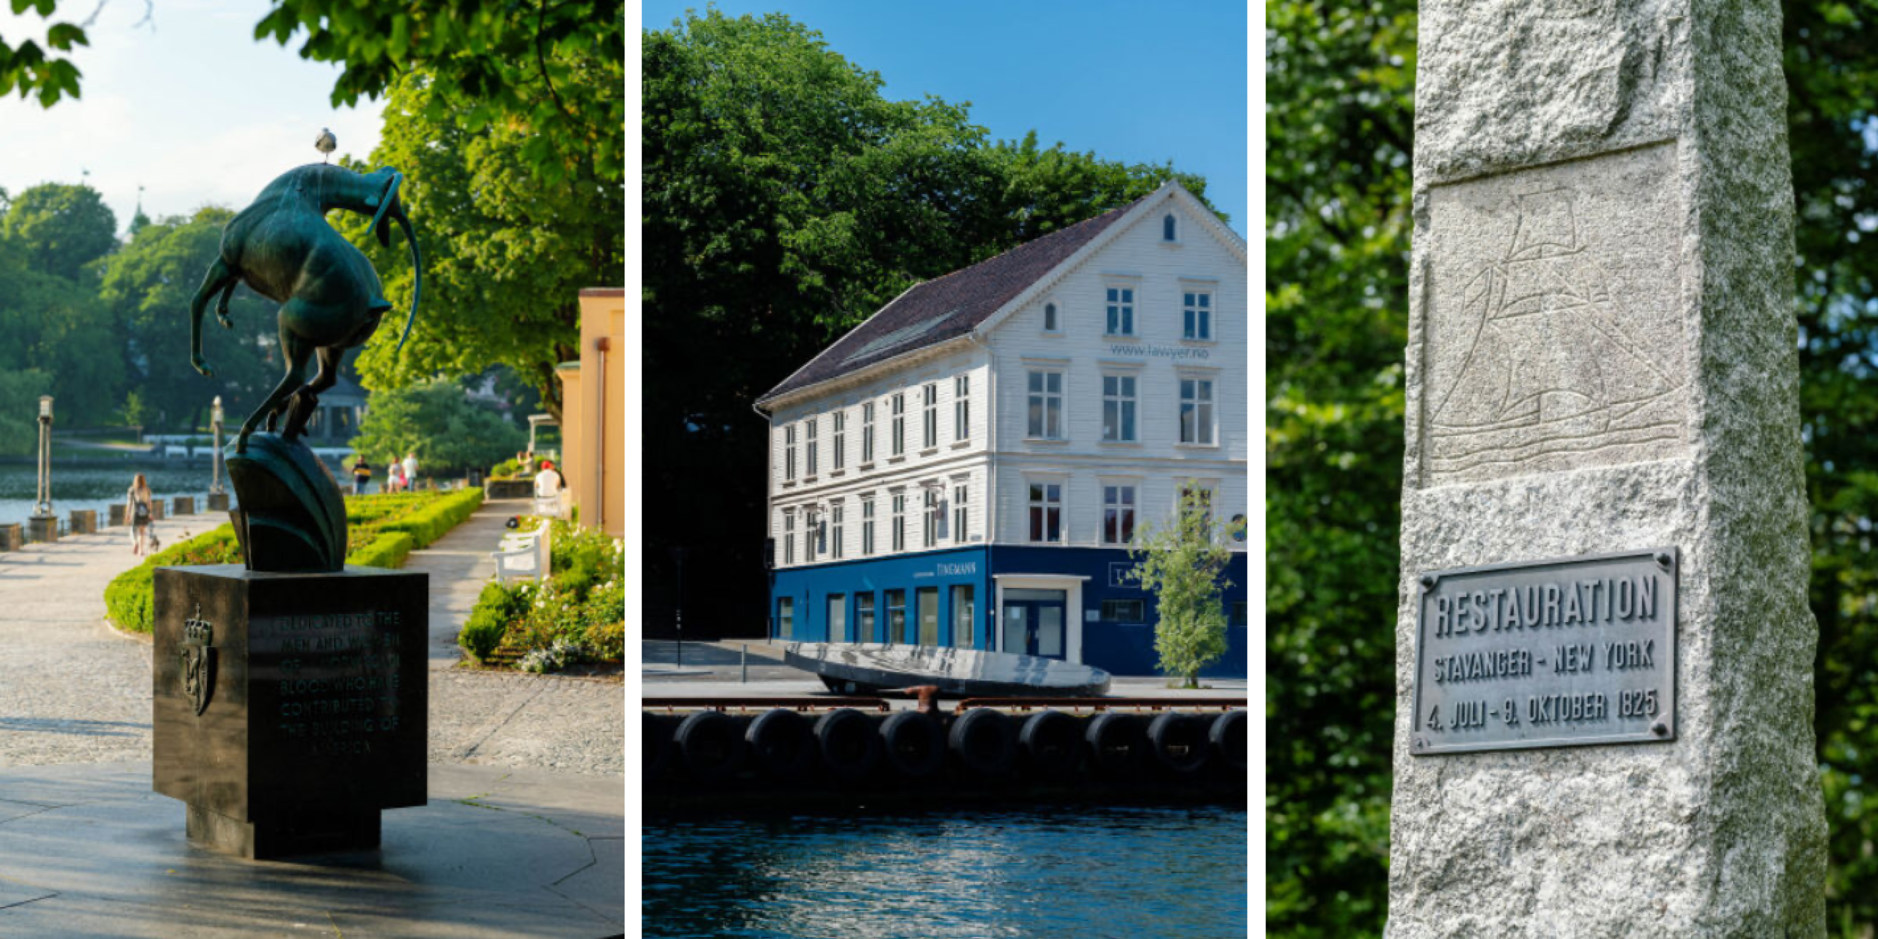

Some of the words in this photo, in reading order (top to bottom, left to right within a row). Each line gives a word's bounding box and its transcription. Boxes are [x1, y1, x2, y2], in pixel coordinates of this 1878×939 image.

[1110, 342, 1209, 360] www.lawyer.no
[1434, 575, 1658, 638] RESTAURATION
[376, 610, 400, 627] THE
[316, 634, 343, 651] AND
[1434, 649, 1532, 683] STAVANGER
[1553, 643, 1595, 675] NEW
[1603, 638, 1655, 669] YORK
[281, 677, 329, 697] BLOOD
[333, 676, 366, 693] WHO
[367, 672, 400, 690] HAVE
[1427, 703, 1444, 732] 4.
[1450, 699, 1486, 731] JULI
[1528, 691, 1608, 724] OKTOBER
[1616, 687, 1658, 718] 1825
[379, 714, 400, 731] OF
